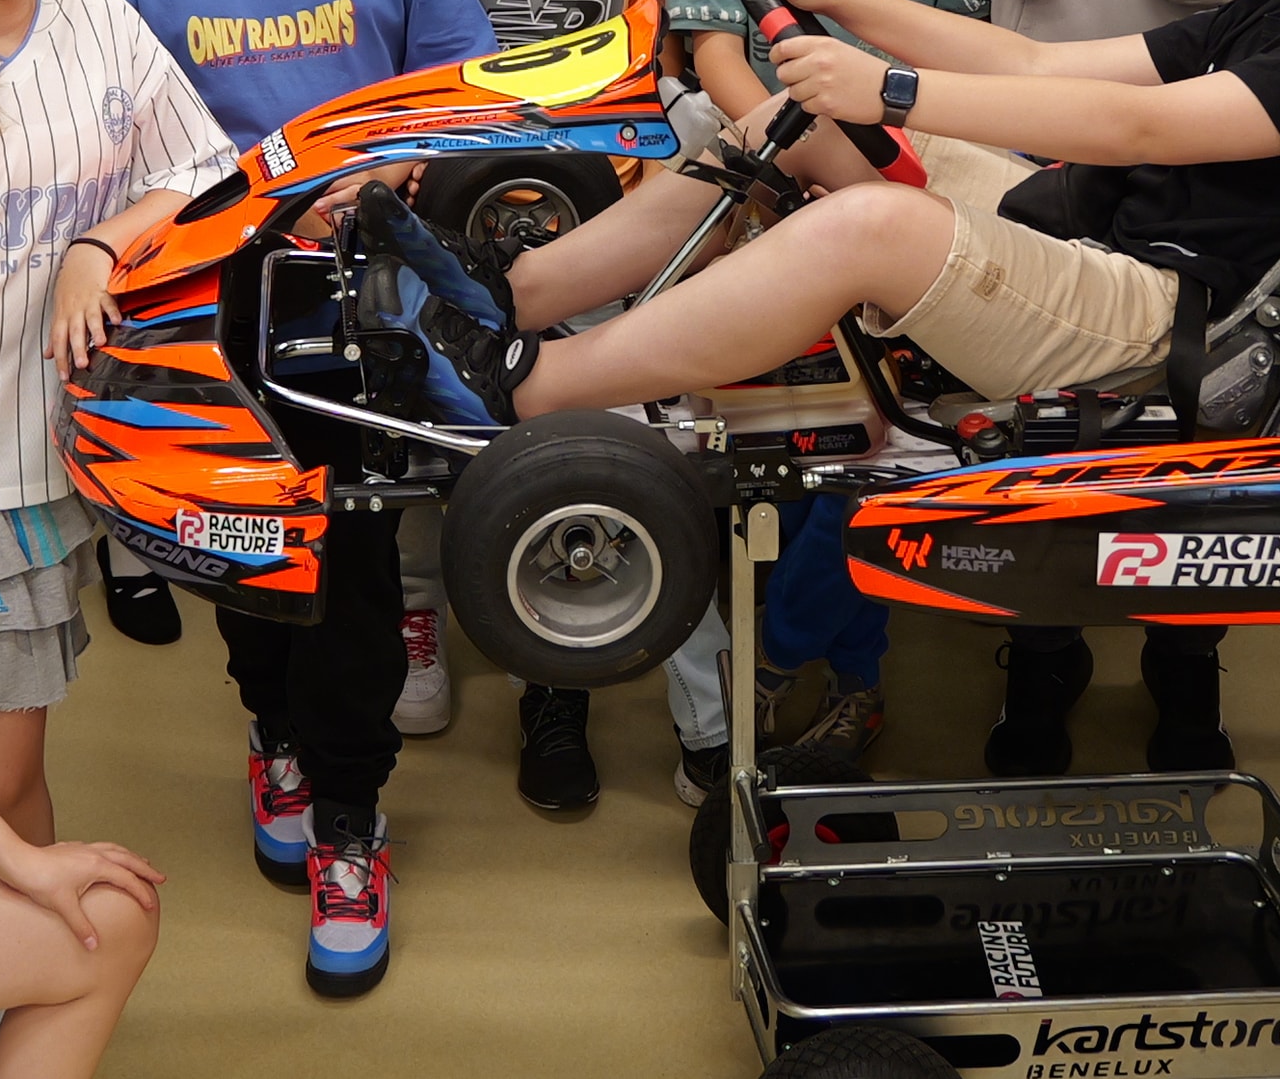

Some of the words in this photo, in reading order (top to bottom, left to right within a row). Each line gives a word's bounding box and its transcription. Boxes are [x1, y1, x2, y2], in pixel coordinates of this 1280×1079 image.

[187, 15, 245, 66] ONLY
[246, 14, 298, 51] RAD
[209, 57, 234, 68] LIVE
[270, 50, 305, 62] SKATE
[432, 133, 522, 150] ACCELERATING
[524, 129, 572, 144] TALENT
[209, 515, 280, 535] RACING
[111, 521, 230, 578] RACING
[209, 532, 279, 554] FUTURE
[942, 544, 1016, 562] HENZA
[941, 559, 1004, 573] KART
[978, 922, 1016, 987] RACING
[1003, 922, 1042, 989] FUTURE
[1026, 1058, 1175, 1079] BENELUX
